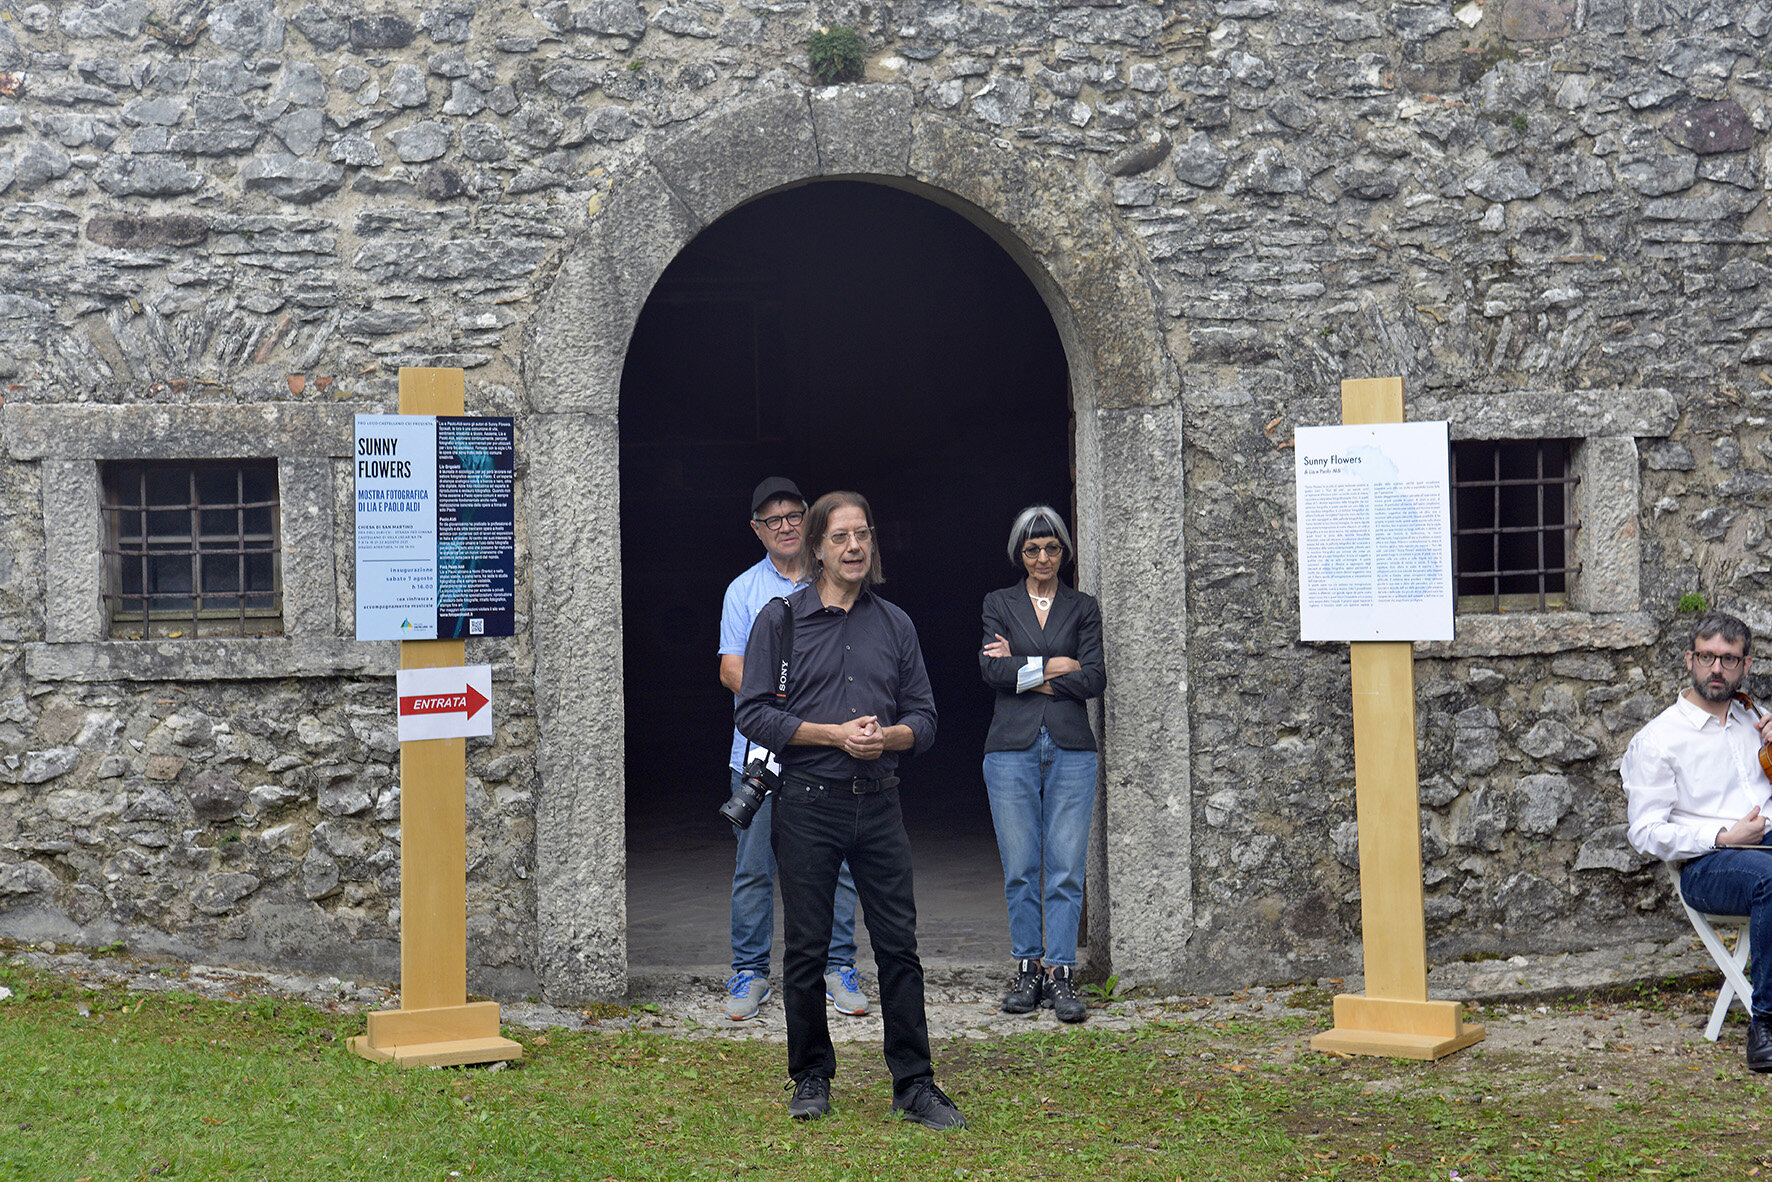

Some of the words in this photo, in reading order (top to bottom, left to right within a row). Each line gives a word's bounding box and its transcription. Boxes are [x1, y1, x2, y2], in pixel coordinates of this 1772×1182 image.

[358, 438, 398, 455] SUNNY
[1304, 456, 1328, 467] Sunny
[1331, 455, 1361, 464] Flowers
[359, 461, 411, 478] FLOWERS
[358, 490, 385, 500] MOSTRA
[386, 490, 428, 500] FOTOGRAFICA
[358, 502, 365, 512] DI
[367, 502, 377, 512] LIA
[379, 502, 382, 512] E
[384, 502, 404, 512] PAOLO
[406, 502, 420, 512] ALDI
[779, 660, 788, 691] SONY
[414, 697, 466, 710] ENTRATA
